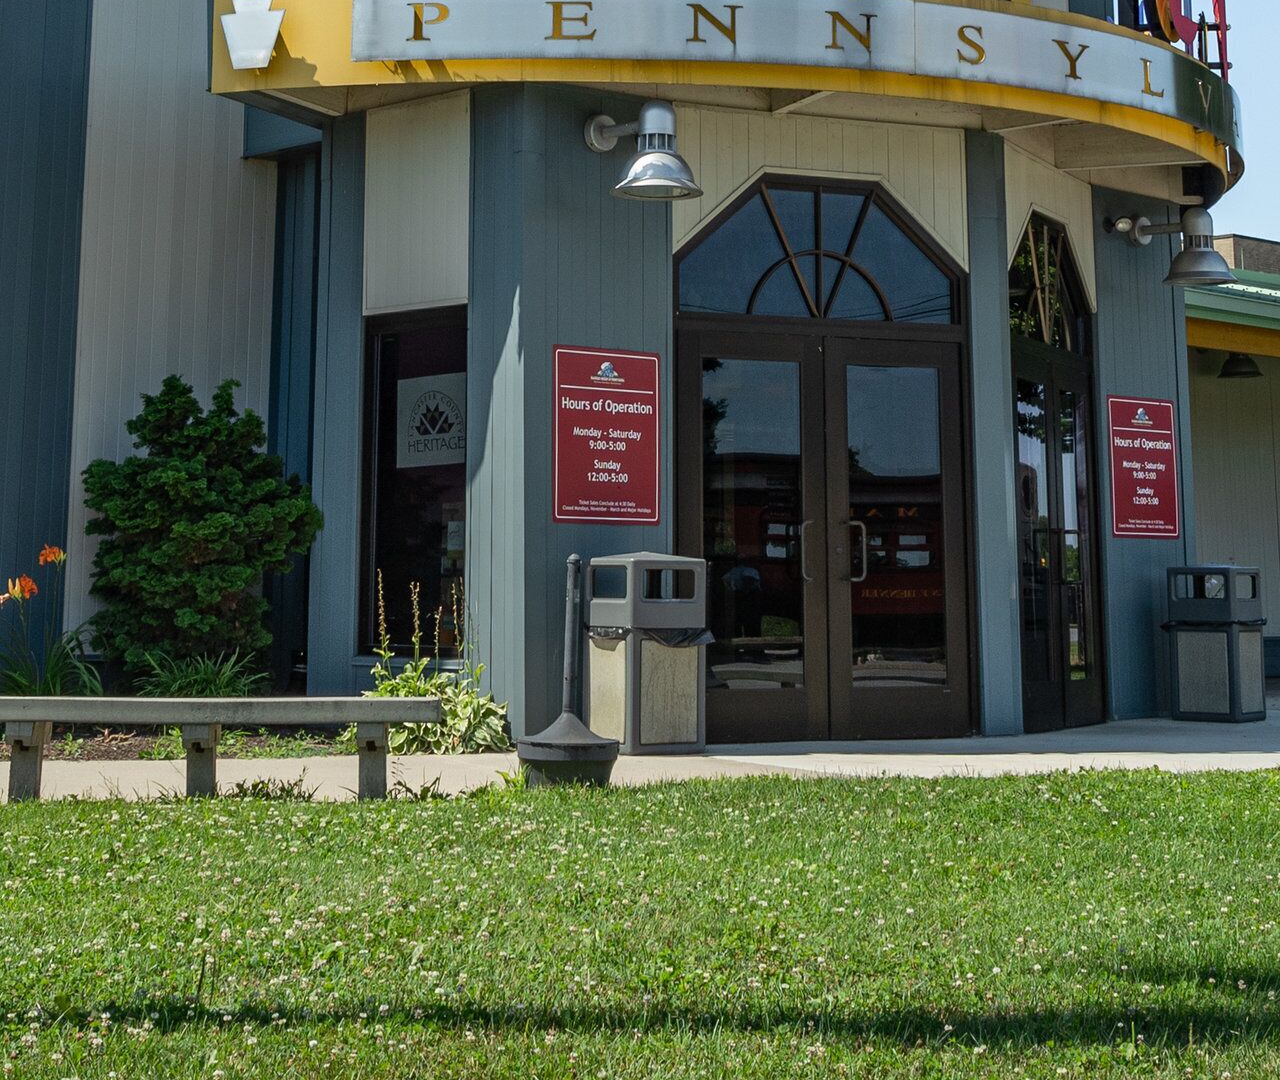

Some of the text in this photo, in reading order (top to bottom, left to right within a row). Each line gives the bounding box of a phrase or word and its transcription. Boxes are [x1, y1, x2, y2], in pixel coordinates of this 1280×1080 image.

[561, 396, 653, 415] Hours of Operation
[573, 426, 602, 439] Monday
[608, 428, 641, 441] Saturday
[407, 436, 466, 453] HERITAGE
[589, 440, 626, 451] 9:00-5:00
[1114, 436, 1172, 451] Hours of Operation
[594, 459, 621, 471] Sunday
[1122, 460, 1141, 471] Monday
[1145, 461, 1166, 472] Saturday
[587, 472, 628, 483] 12:00-5:00
[1132, 470, 1157, 480] 9:00-5:00
[1136, 486, 1154, 496] Sunday
[1132, 496, 1159, 505] 12:00-5:00
